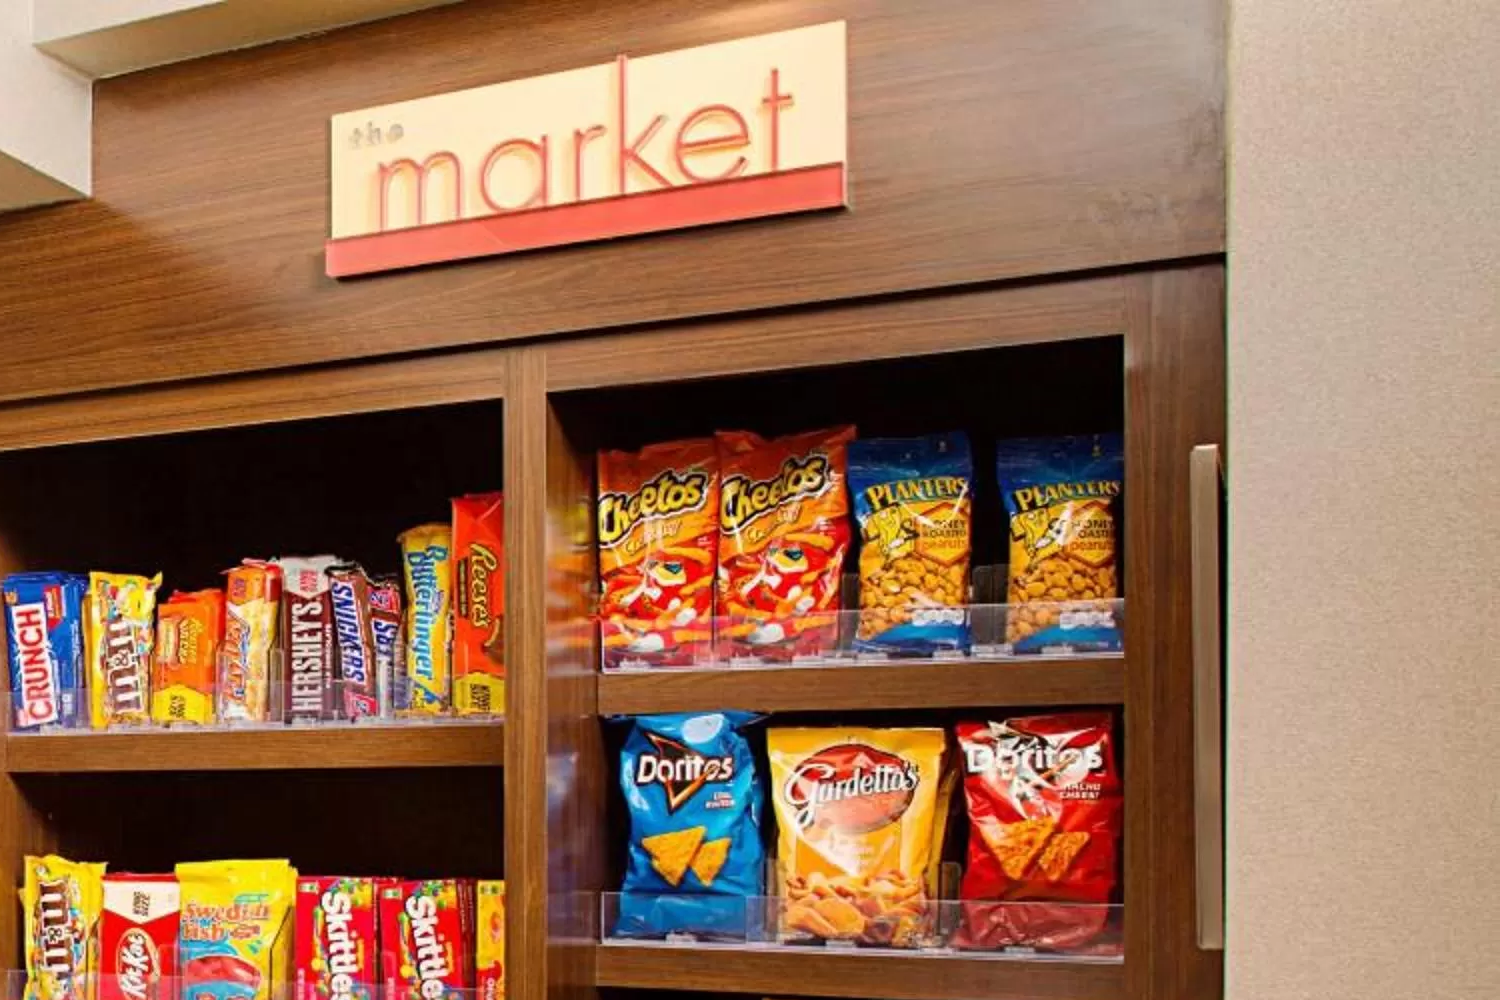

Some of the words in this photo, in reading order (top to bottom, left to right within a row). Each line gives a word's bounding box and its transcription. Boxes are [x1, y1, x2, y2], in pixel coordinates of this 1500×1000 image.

[350, 120, 404, 148] the
[379, 54, 793, 232] market
[600, 473, 705, 542] Cheetos
[722, 459, 825, 529] Cheetos
[867, 477, 966, 510] PLANTERS
[1016, 480, 1120, 511] PLANTERS
[407, 546, 448, 681] Butterfinger
[470, 543, 497, 629] Reese's
[14, 607, 54, 720] CRUNCH
[291, 602, 324, 712] HERSHEY'S
[331, 581, 365, 683] SNICKERS
[637, 755, 733, 783] Doritos
[965, 742, 1103, 774] Doritos
[184, 922, 225, 941] Fish
